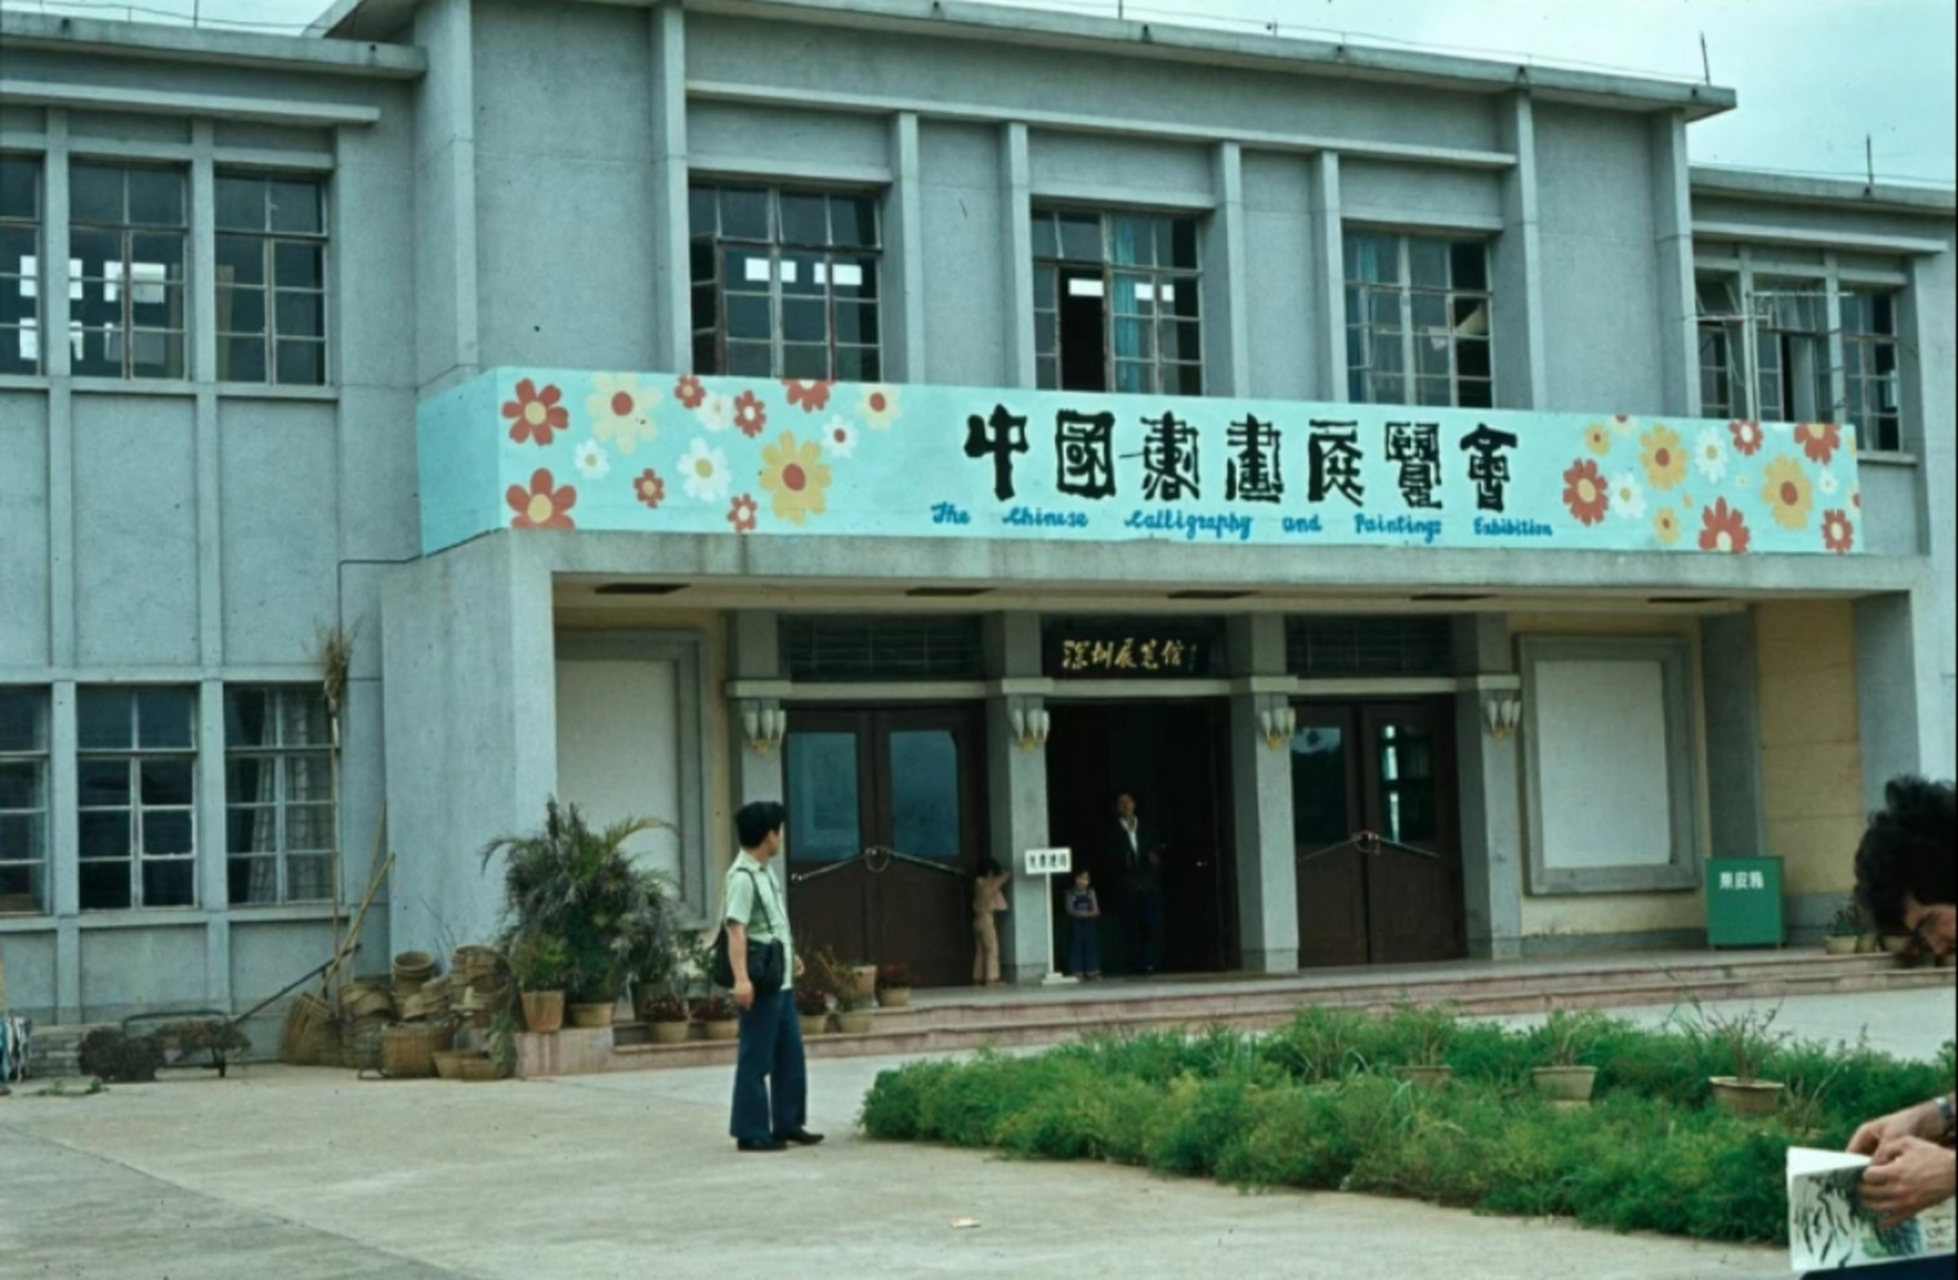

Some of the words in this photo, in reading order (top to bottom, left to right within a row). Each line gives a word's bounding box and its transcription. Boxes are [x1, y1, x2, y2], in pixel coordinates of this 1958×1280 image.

[930, 501, 971, 525] The
[1001, 506, 1089, 528] Chinese
[1123, 509, 1254, 541] Calligraphy
[1282, 513, 1323, 533] and
[1353, 512, 1443, 544] Paintings
[1472, 516, 1554, 538] Exhibition
